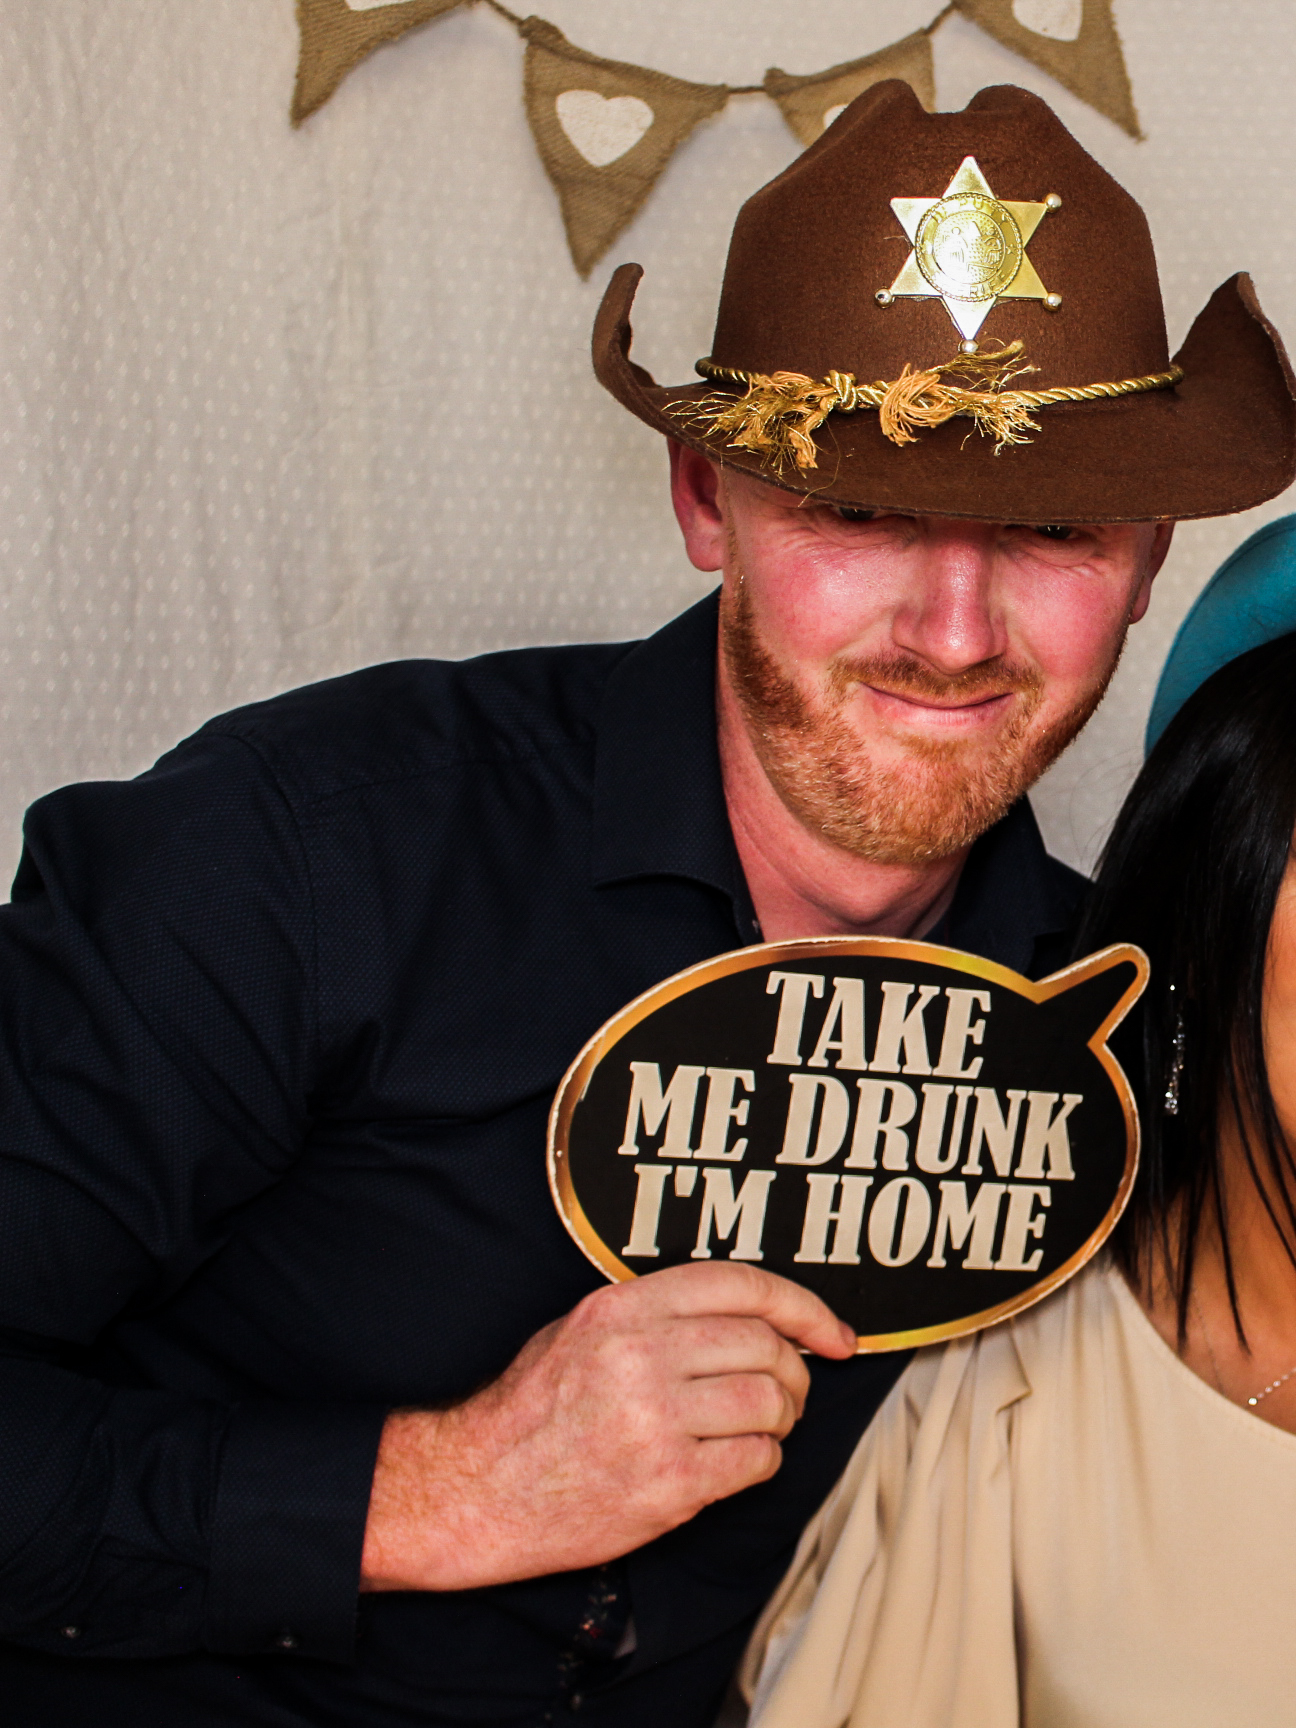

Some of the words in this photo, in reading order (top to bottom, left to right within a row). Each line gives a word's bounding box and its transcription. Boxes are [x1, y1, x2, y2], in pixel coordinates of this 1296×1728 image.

[766, 970, 992, 1080] TAKE
[617, 1061, 756, 1162] ME
[775, 1072, 1084, 1181] DRUNK
[621, 1163, 777, 1261] I'M
[793, 1172, 1052, 1272] HOME
